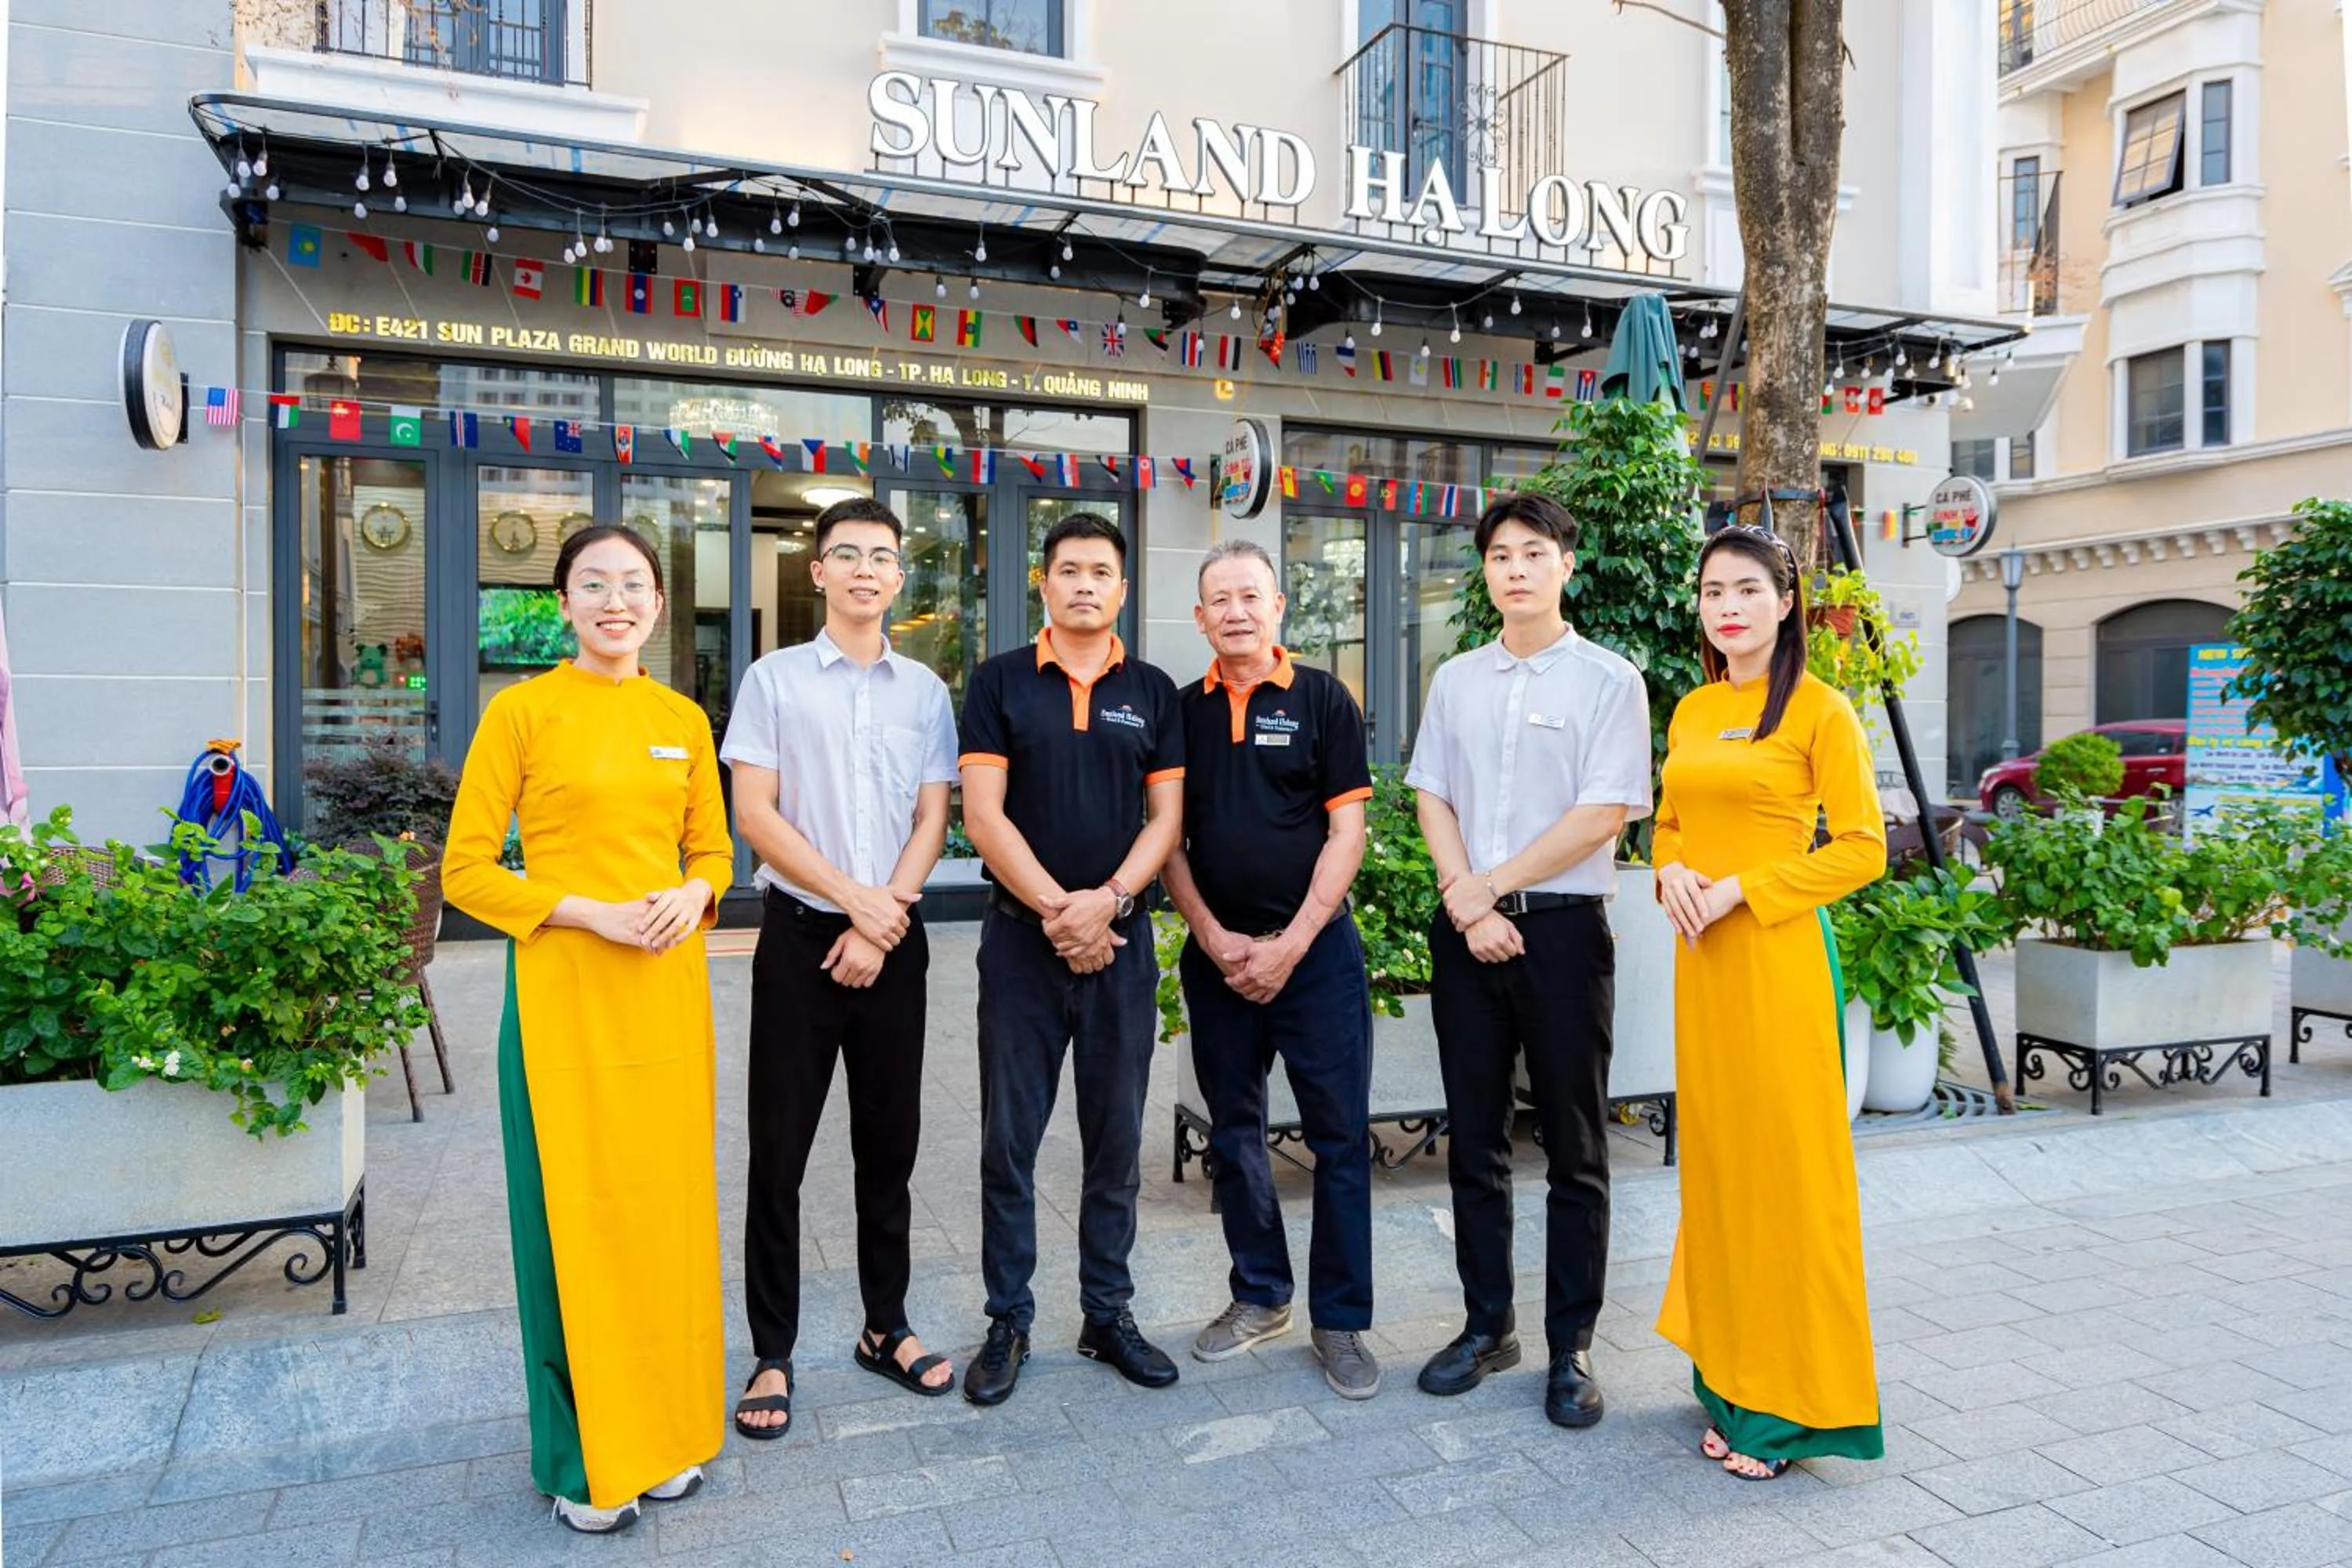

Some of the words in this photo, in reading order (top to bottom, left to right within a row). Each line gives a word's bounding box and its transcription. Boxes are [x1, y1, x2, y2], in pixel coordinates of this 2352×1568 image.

[867, 70, 1316, 207] SUNLAND
[1343, 143, 1465, 247] HẠ
[1475, 166, 1690, 262] LONG
[376, 316, 428, 339] E421
[437, 321, 482, 344] SUN
[491, 326, 561, 351] PLAZA
[568, 333, 640, 359] GRAND
[646, 340, 718, 365] WORLD
[725, 342, 794, 372] ĐƯỜNG
[800, 353, 827, 376] HẠ
[833, 356, 882, 379] LONG
[962, 367, 1007, 388] LONG
[1044, 372, 1102, 397] QUẢNG
[1108, 381, 1149, 401] NINH
